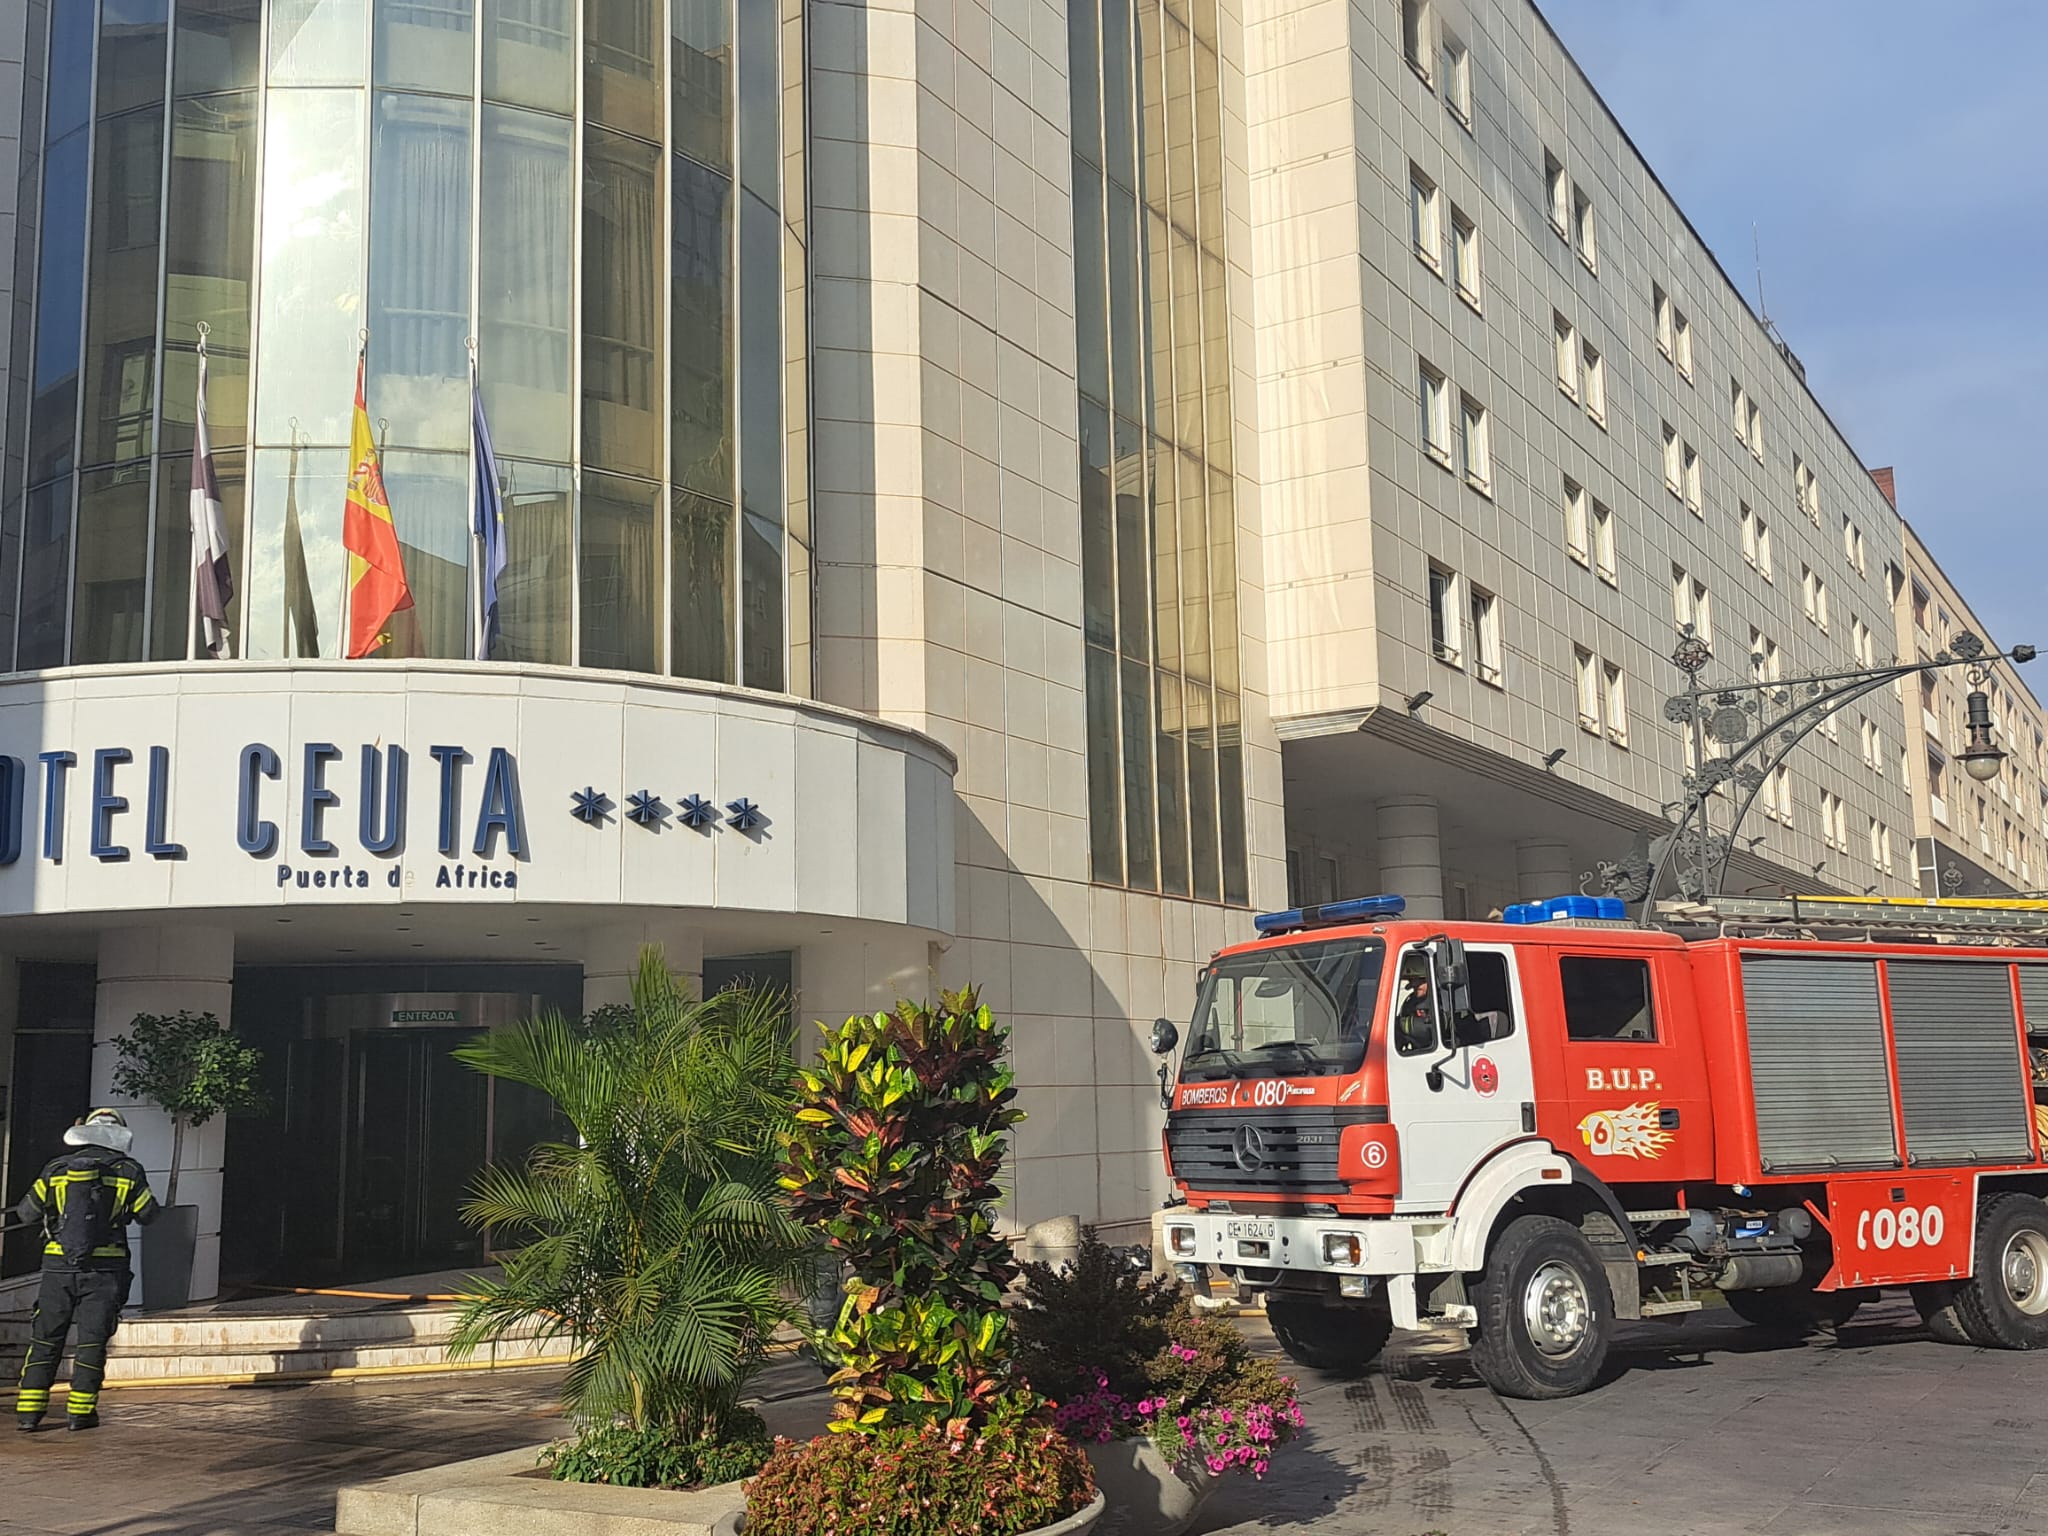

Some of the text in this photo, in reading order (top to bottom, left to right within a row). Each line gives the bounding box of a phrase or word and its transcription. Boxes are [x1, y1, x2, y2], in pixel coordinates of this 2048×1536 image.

[236, 742, 528, 860] CEUTA
[277, 864, 370, 888] Puerta
[435, 864, 518, 889] Africa
[398, 1010, 455, 1021] ENTRADA
[1585, 1068, 1663, 1091] B.U.P.
[1181, 1087, 1228, 1105] BOMBEROS
[1254, 1080, 1287, 1106] 080
[1296, 1135, 1323, 1144] 2031
[1594, 1121, 1608, 1145] 6
[1367, 1145, 1381, 1164] 6
[1872, 1204, 1944, 1250] 080
